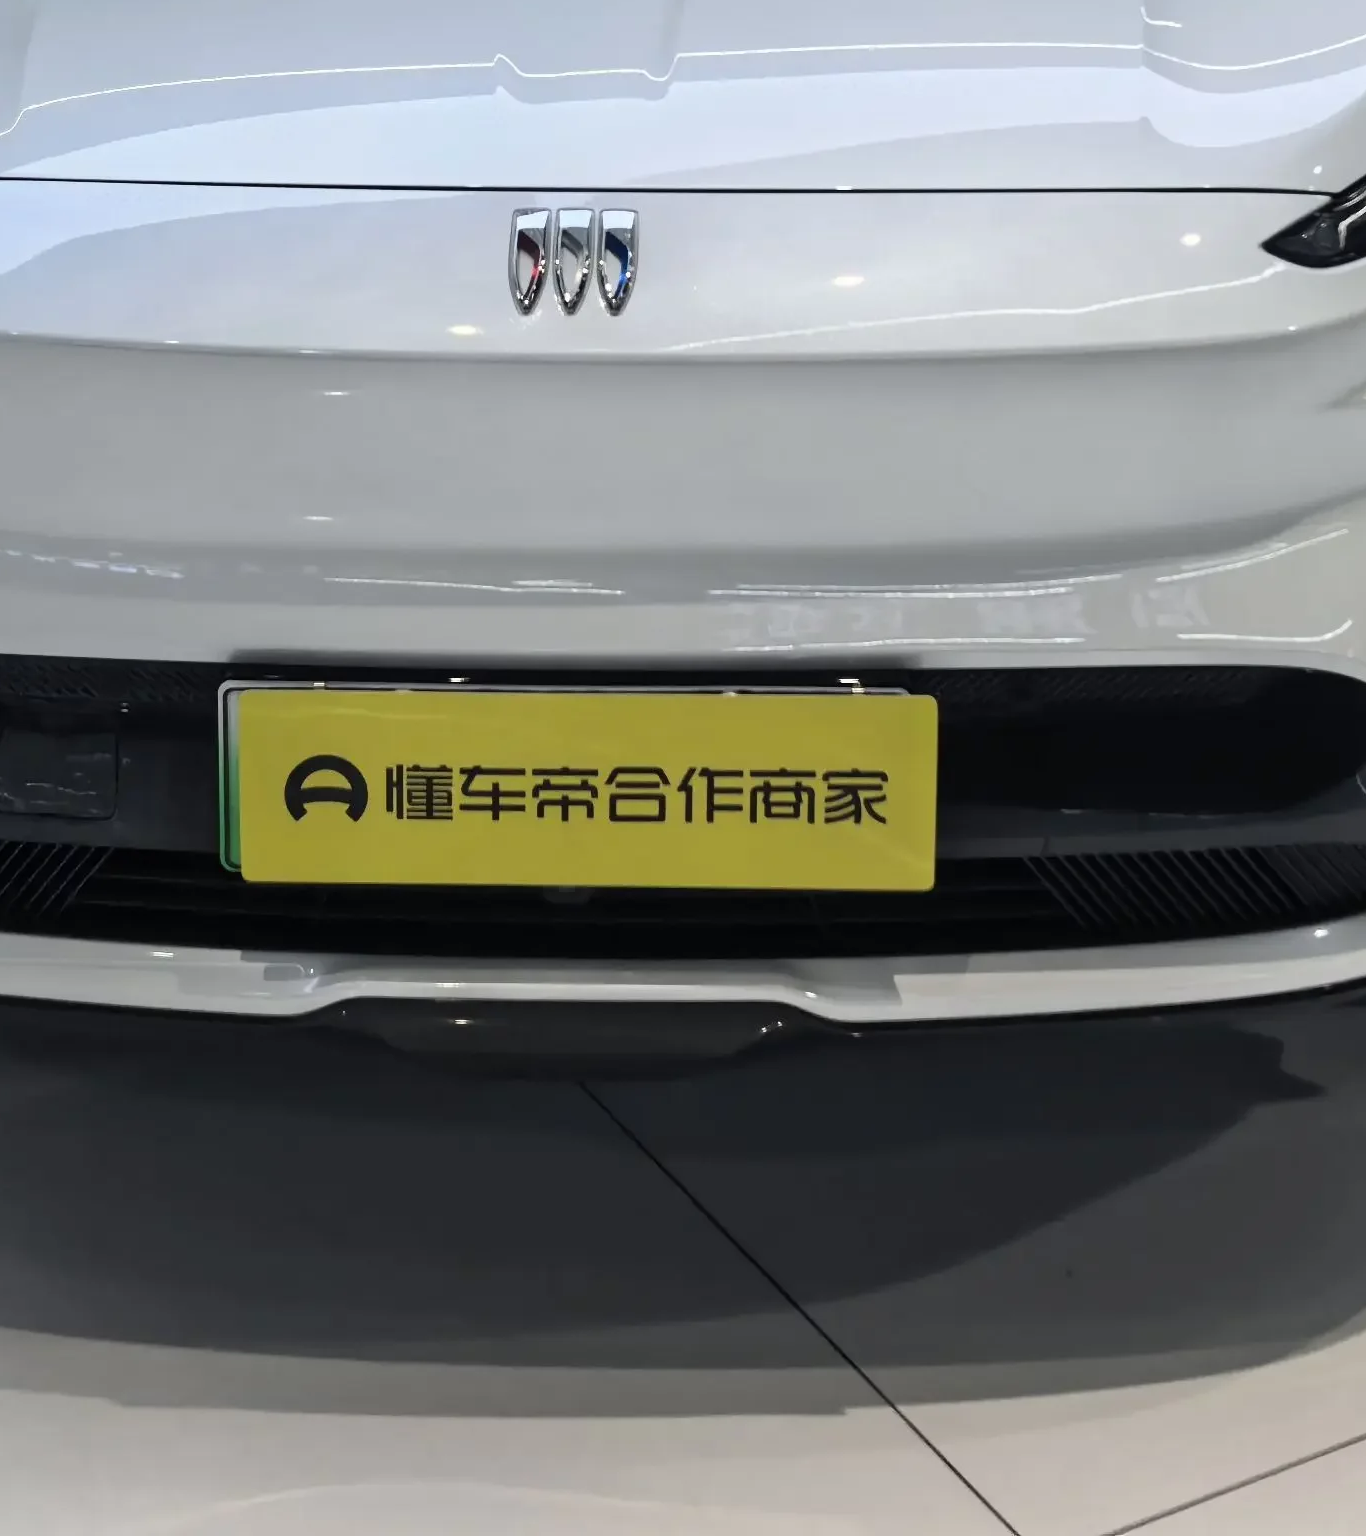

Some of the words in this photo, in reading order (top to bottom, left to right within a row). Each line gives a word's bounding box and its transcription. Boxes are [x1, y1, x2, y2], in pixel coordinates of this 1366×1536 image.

[386, 765, 889, 824] 懂车帝合作商家
